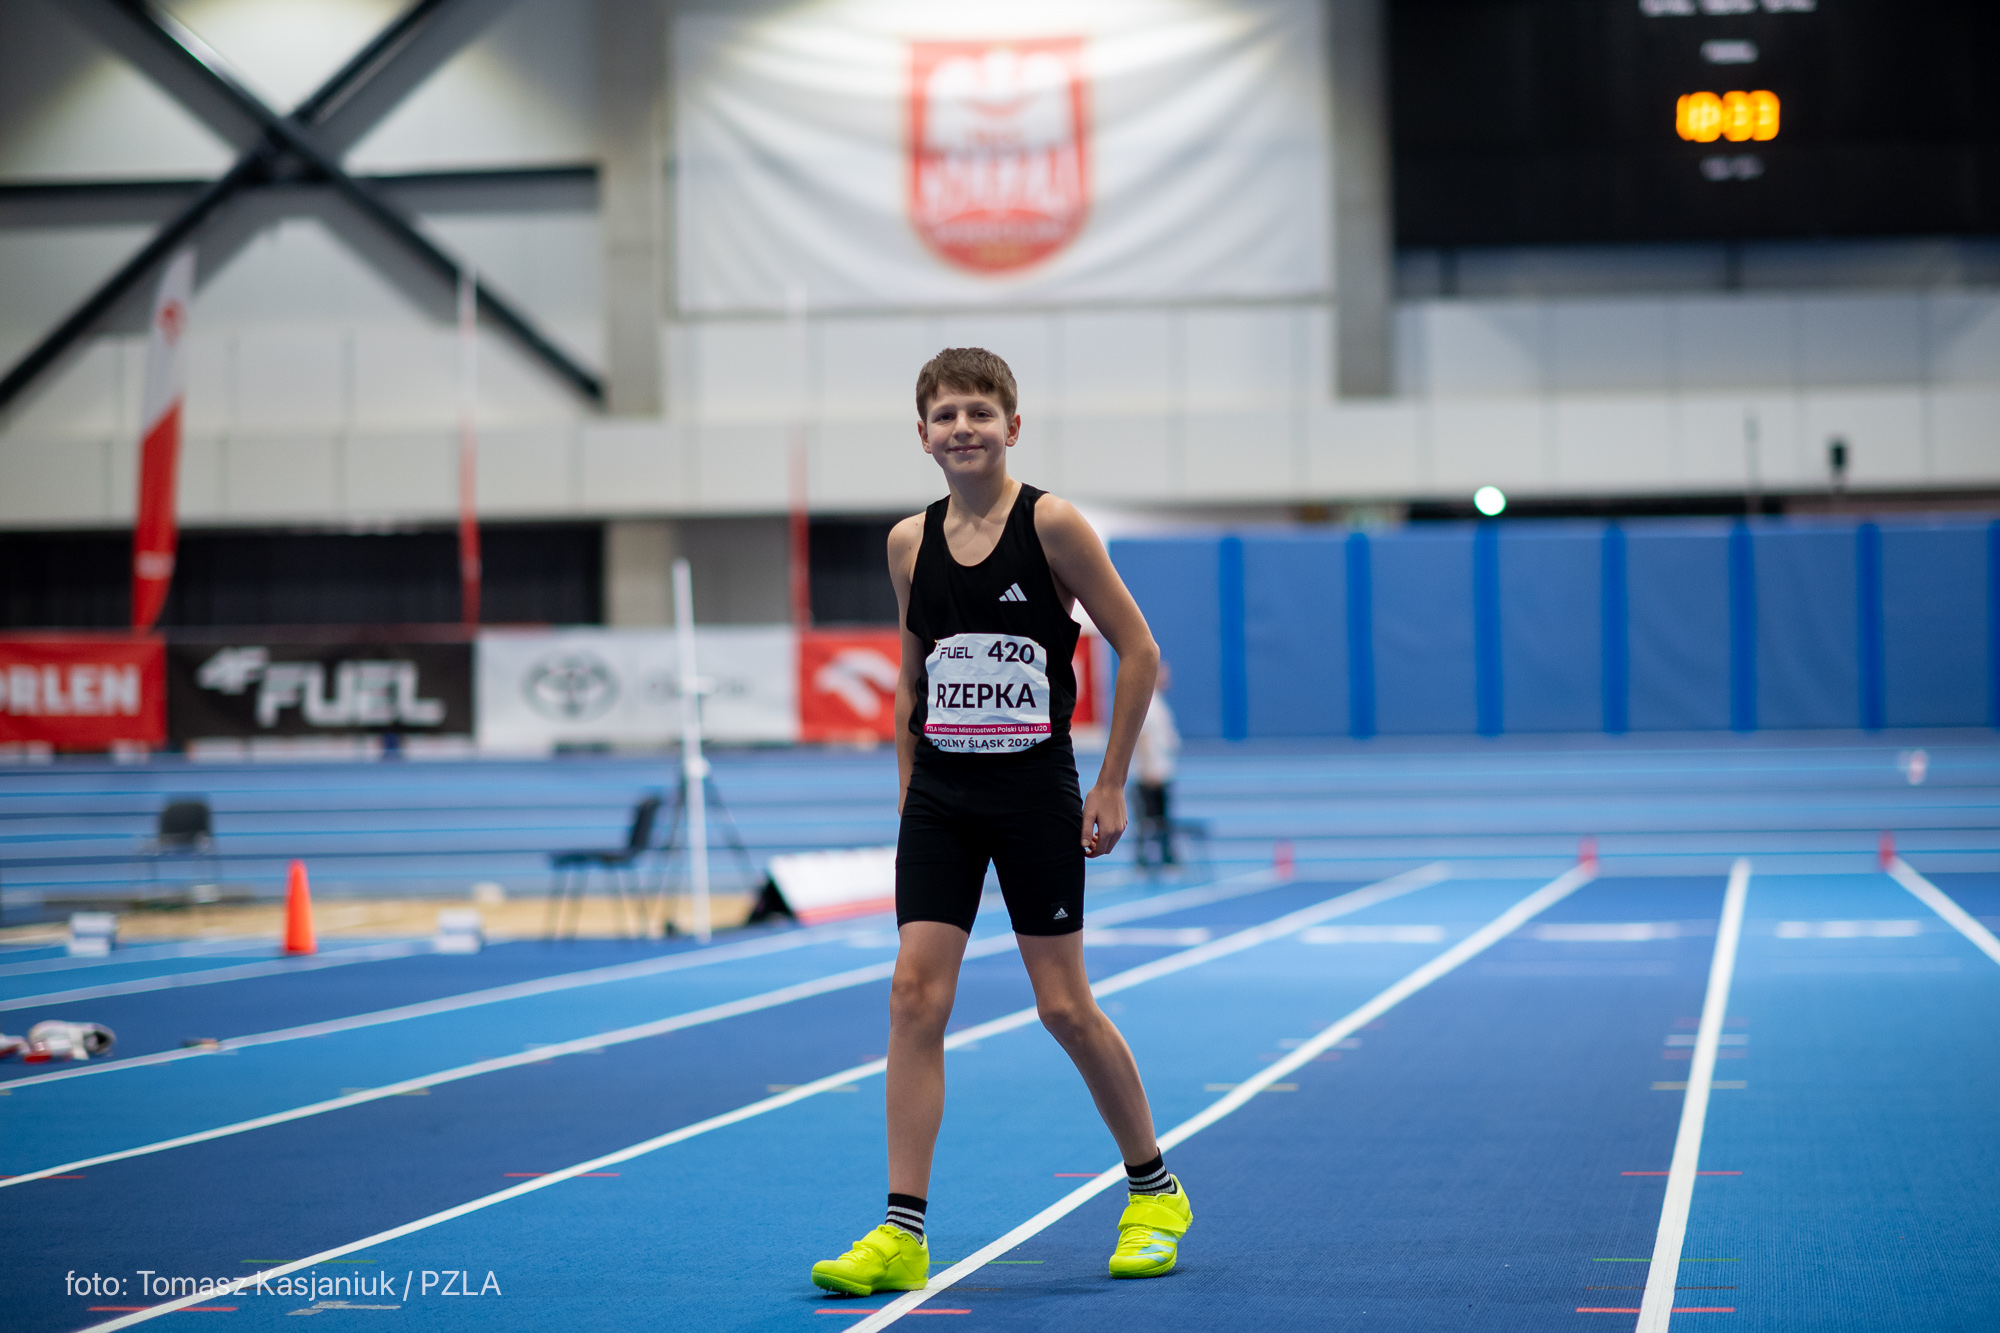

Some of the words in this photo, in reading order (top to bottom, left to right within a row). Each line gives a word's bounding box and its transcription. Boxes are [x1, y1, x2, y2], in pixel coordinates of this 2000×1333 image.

[987, 641, 1035, 664] 420
[0, 663, 141, 717] RLEN
[256, 661, 446, 728] FUEL
[936, 683, 1036, 708] RZEPKA
[934, 738, 965, 748] DOLNY
[968, 737, 1005, 750] ŚLĄSK
[1007, 738, 1037, 747] 2024
